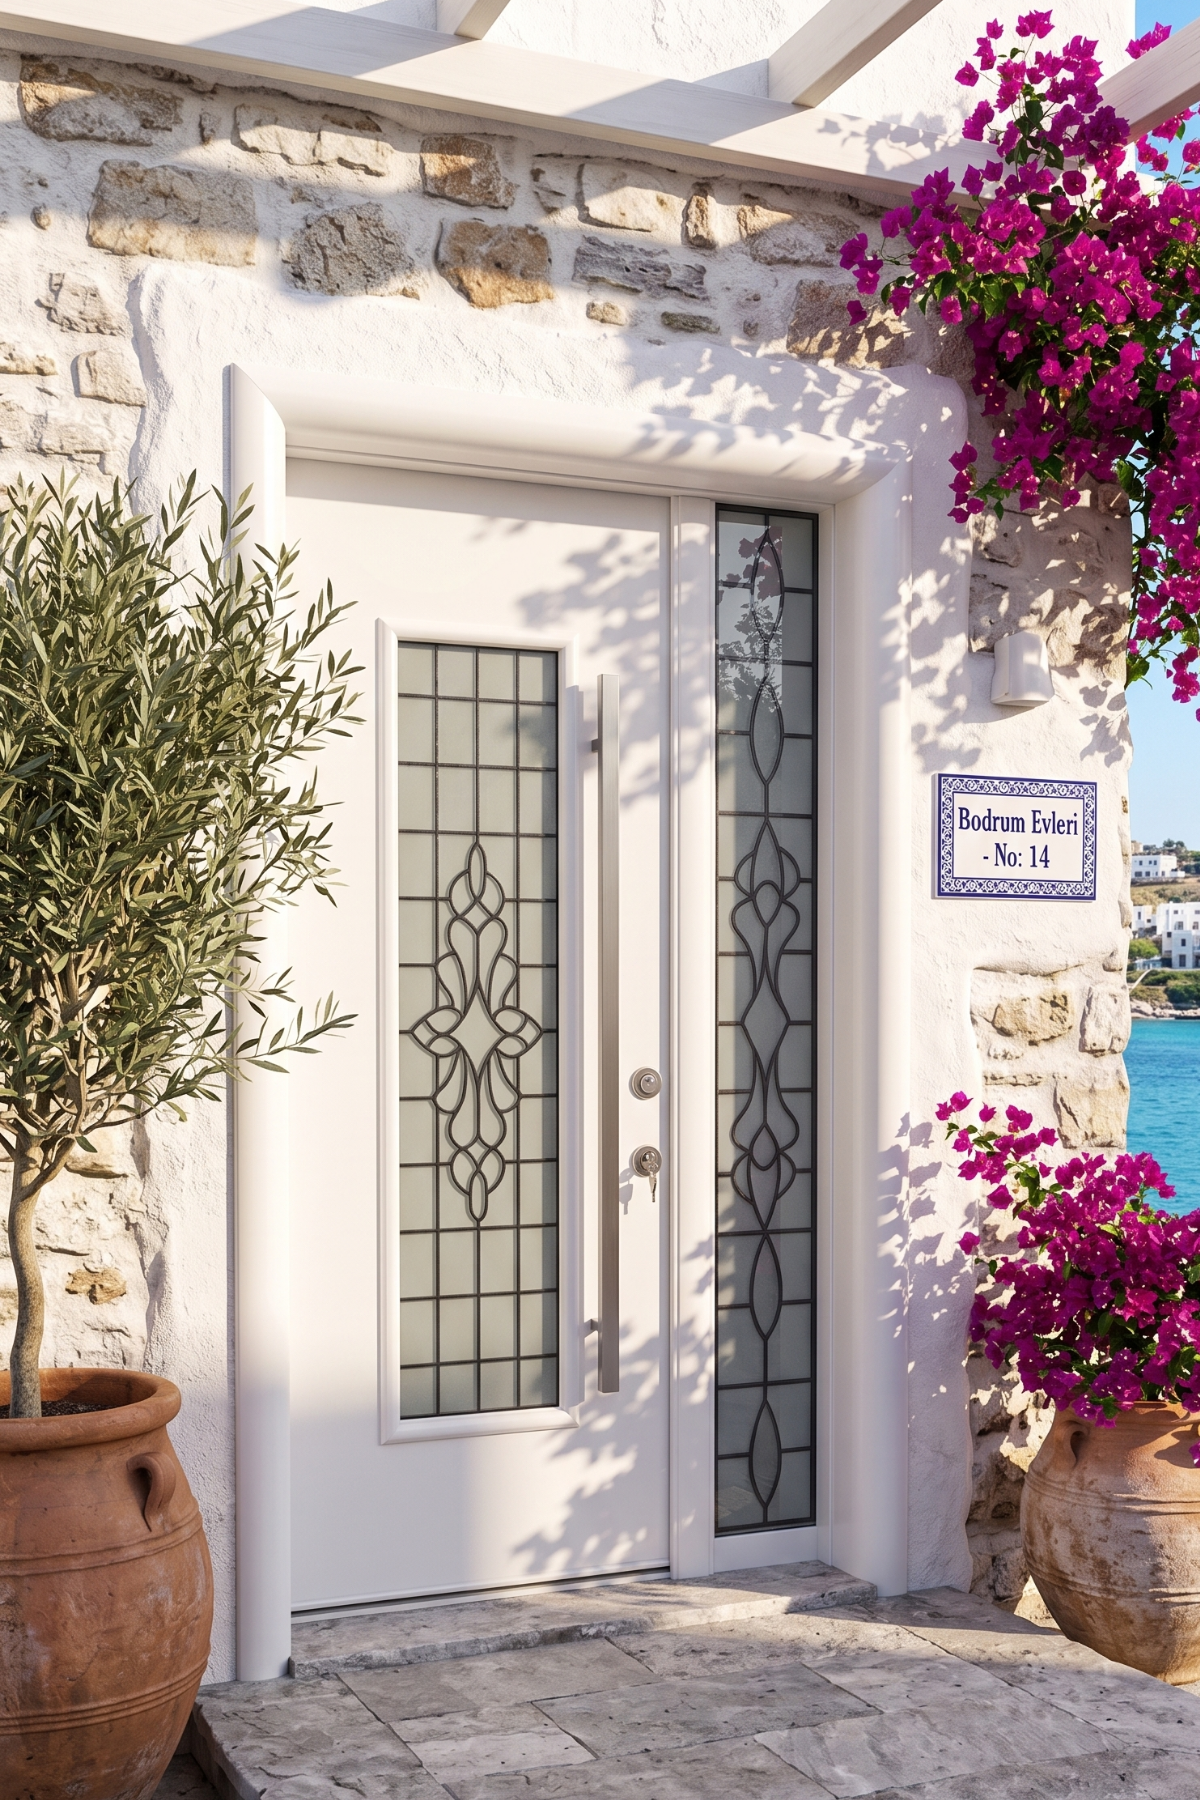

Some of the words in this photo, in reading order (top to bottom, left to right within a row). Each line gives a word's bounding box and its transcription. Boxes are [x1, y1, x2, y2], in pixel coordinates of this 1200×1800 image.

[958, 807, 1025, 833] Bodrum
[1031, 810, 1078, 835] Evleri
[994, 843, 1022, 867] No:
[1029, 845, 1050, 868] 14
